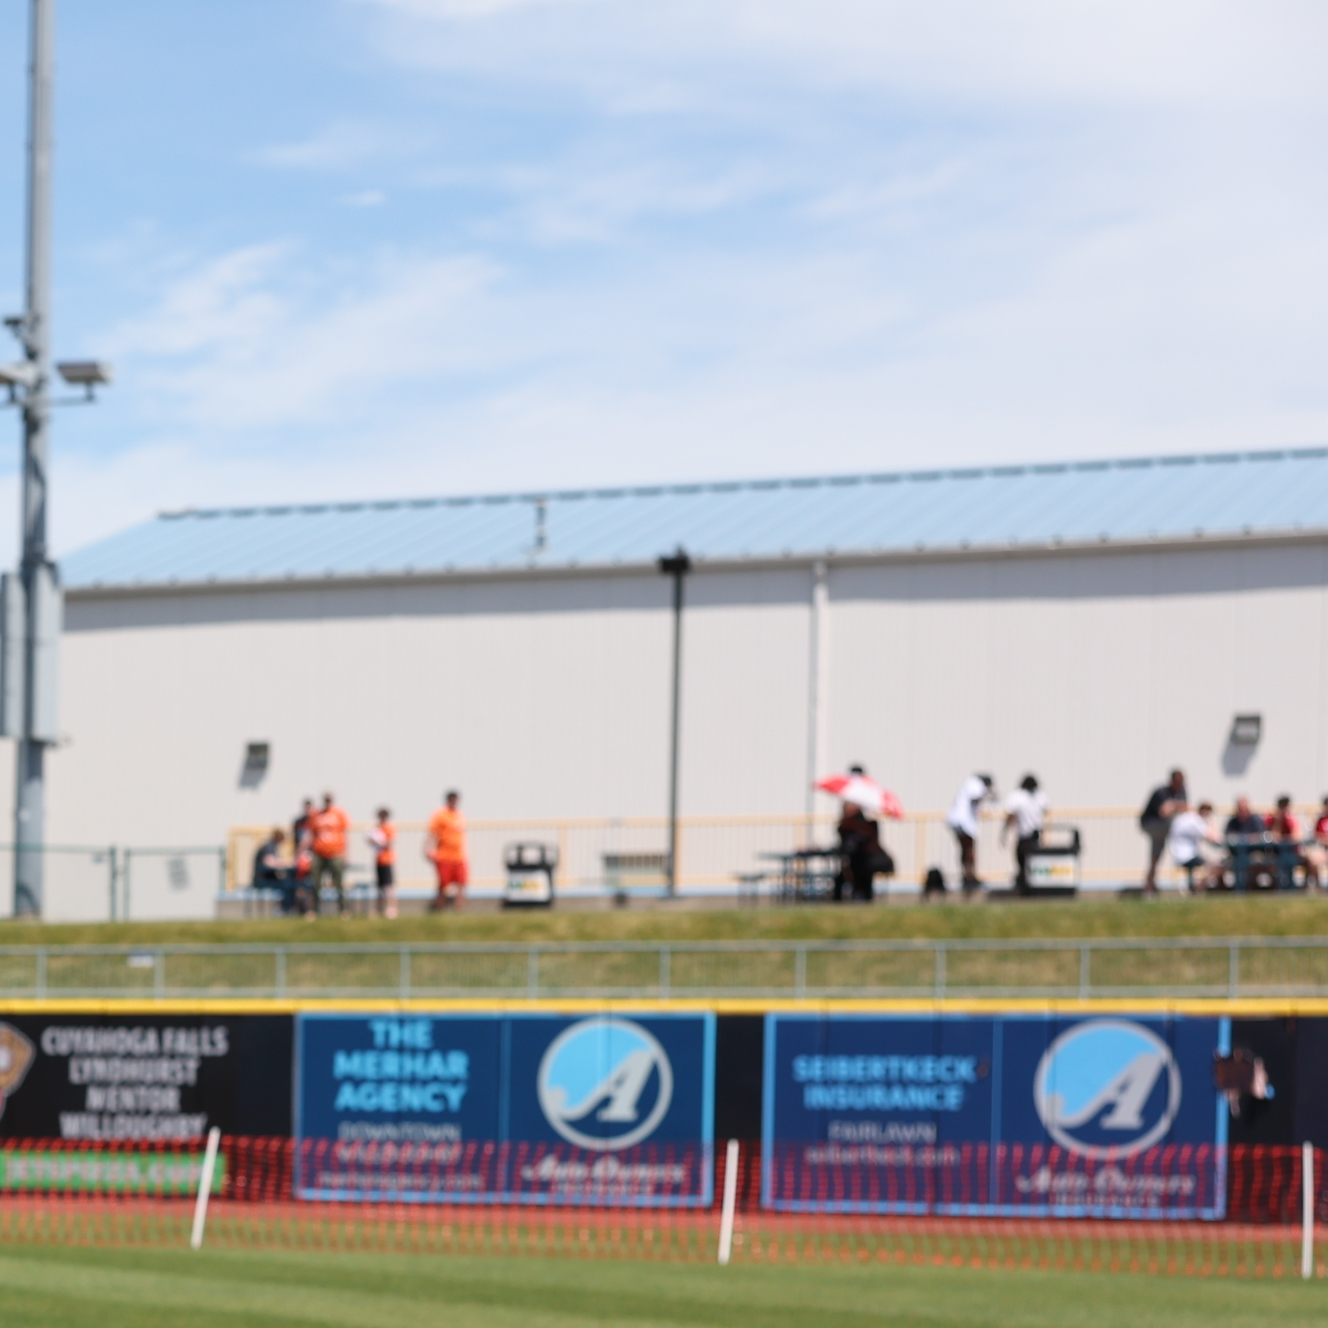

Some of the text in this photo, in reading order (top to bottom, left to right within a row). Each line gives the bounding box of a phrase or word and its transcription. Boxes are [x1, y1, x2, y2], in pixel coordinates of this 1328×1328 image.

[41, 1025, 229, 1057] CUYAHOGA FALLS
[367, 1020, 434, 1051] THE
[68, 1056, 202, 1086] LYNDHURST
[332, 1050, 470, 1081] MERHAR
[790, 1054, 978, 1084] SEIBERTKECK
[85, 1085, 181, 1113] MENTOR
[334, 1082, 468, 1113] AGENCY
[802, 1084, 965, 1112] INSURANCE
[59, 1111, 208, 1143] WILLOUGHBY
[337, 1120, 462, 1143] DOWNTOWN
[827, 1120, 937, 1145] FAIRLAWN
